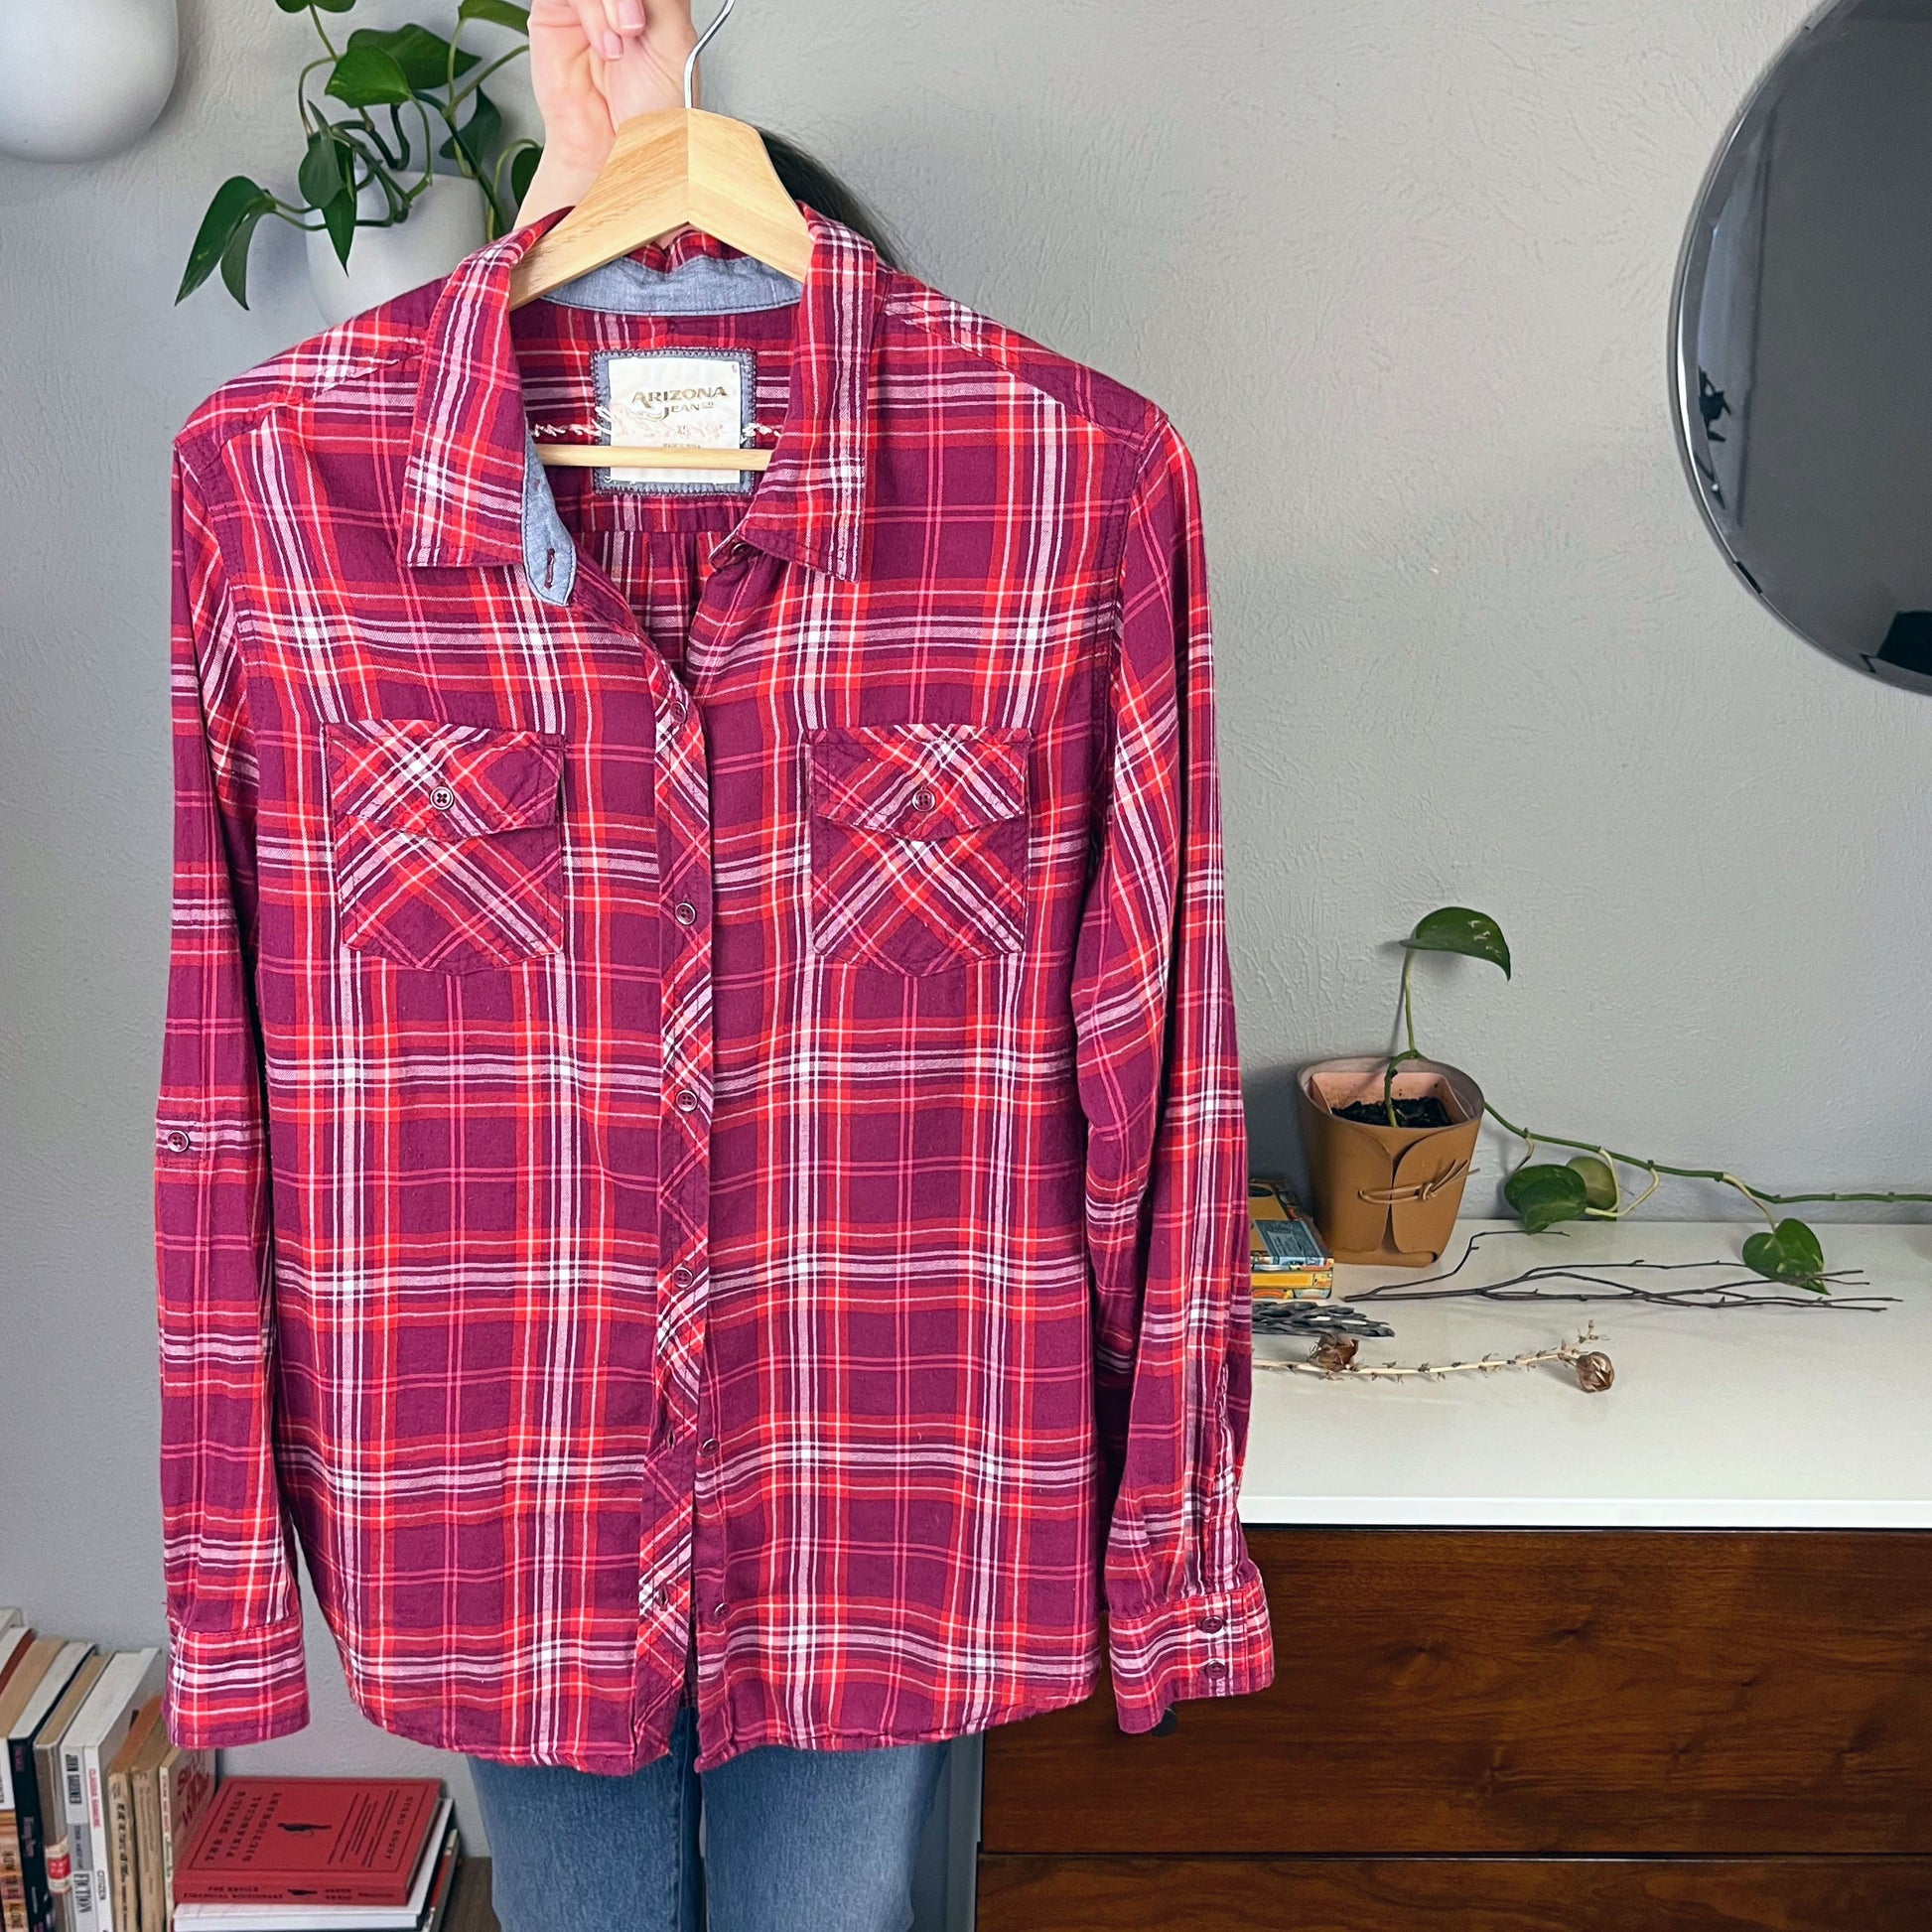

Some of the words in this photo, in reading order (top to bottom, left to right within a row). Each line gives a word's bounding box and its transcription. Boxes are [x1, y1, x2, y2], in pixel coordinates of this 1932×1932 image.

[632, 386, 728, 409] ARIZONA
[663, 403, 700, 420] JEAN
[206, 1839, 222, 1862] THE
[73, 1872, 92, 1913] FICTION
